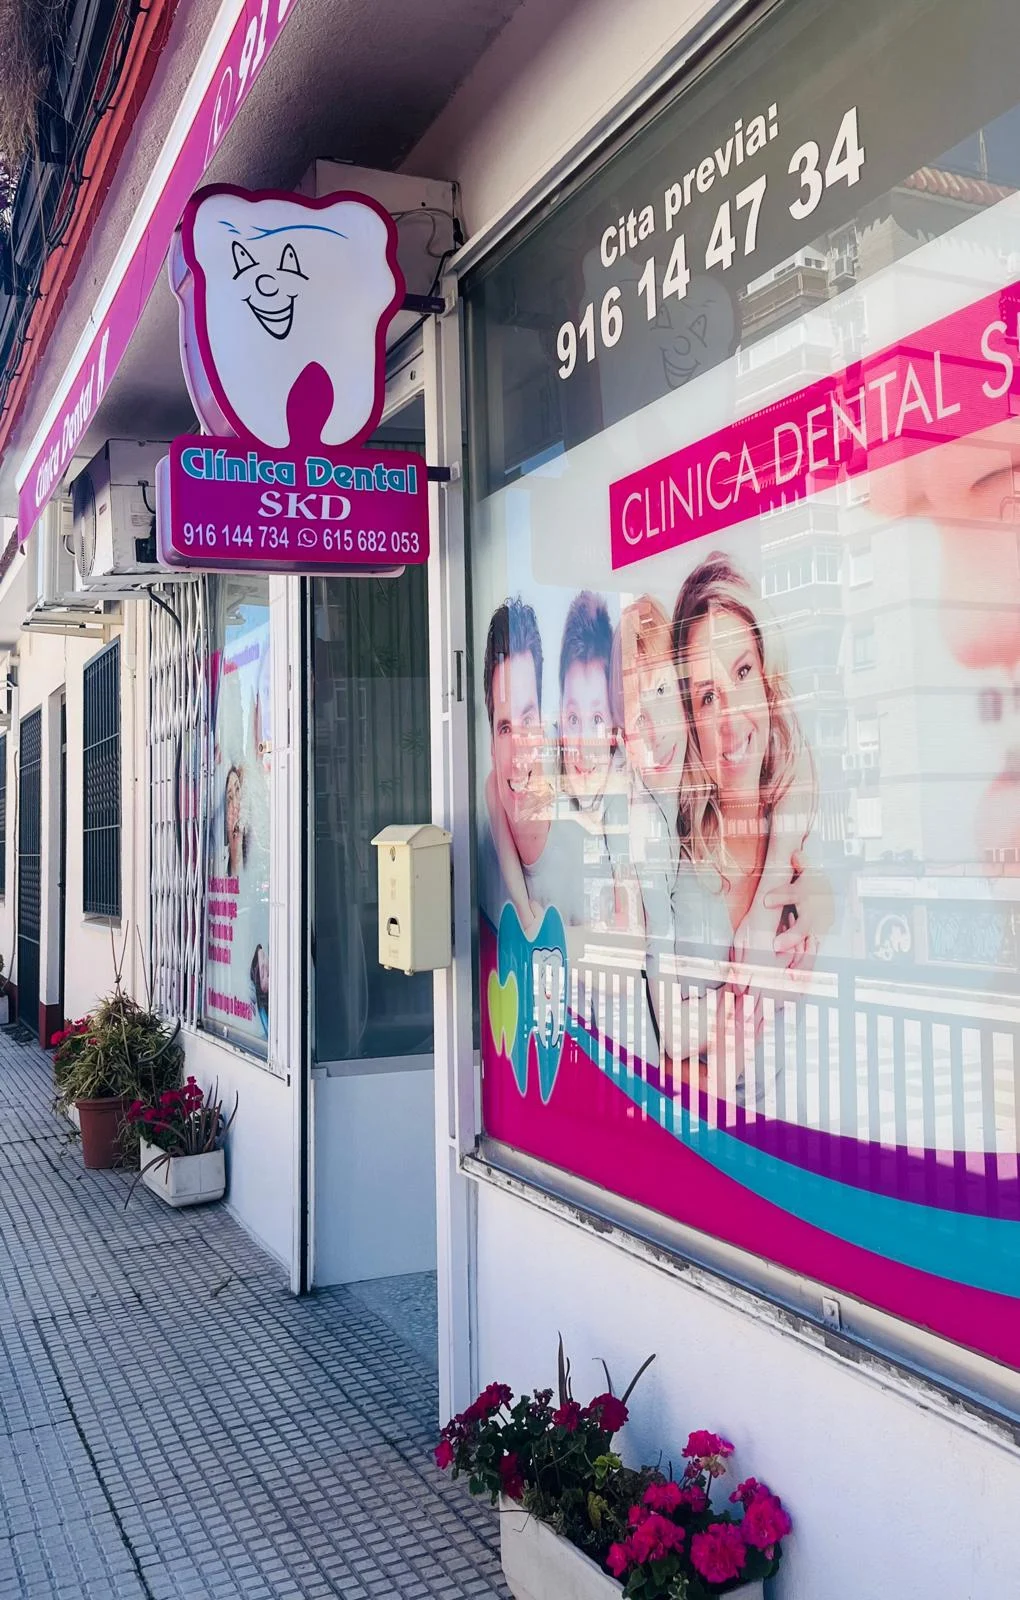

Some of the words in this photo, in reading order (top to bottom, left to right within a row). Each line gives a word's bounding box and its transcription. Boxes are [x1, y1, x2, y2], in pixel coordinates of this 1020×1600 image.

[600, 205, 655, 268] Cita
[664, 102, 778, 232] previa:
[556, 285, 624, 380] 916
[637, 233, 690, 321] 14
[705, 174, 767, 270] 47
[787, 106, 865, 220] 34
[181, 447, 296, 486] Clínica
[305, 455, 418, 494] Dental
[621, 441, 760, 545] CLINICA
[773, 350, 961, 486] DENTAL
[981, 311, 1020, 399] S
[183, 522, 217, 547] 916
[221, 524, 254, 548] 144
[258, 526, 289, 548] 734
[322, 528, 353, 550] 615
[357, 530, 387, 552] 682
[391, 532, 419, 553] 053
[257, 490, 351, 521] SKD
